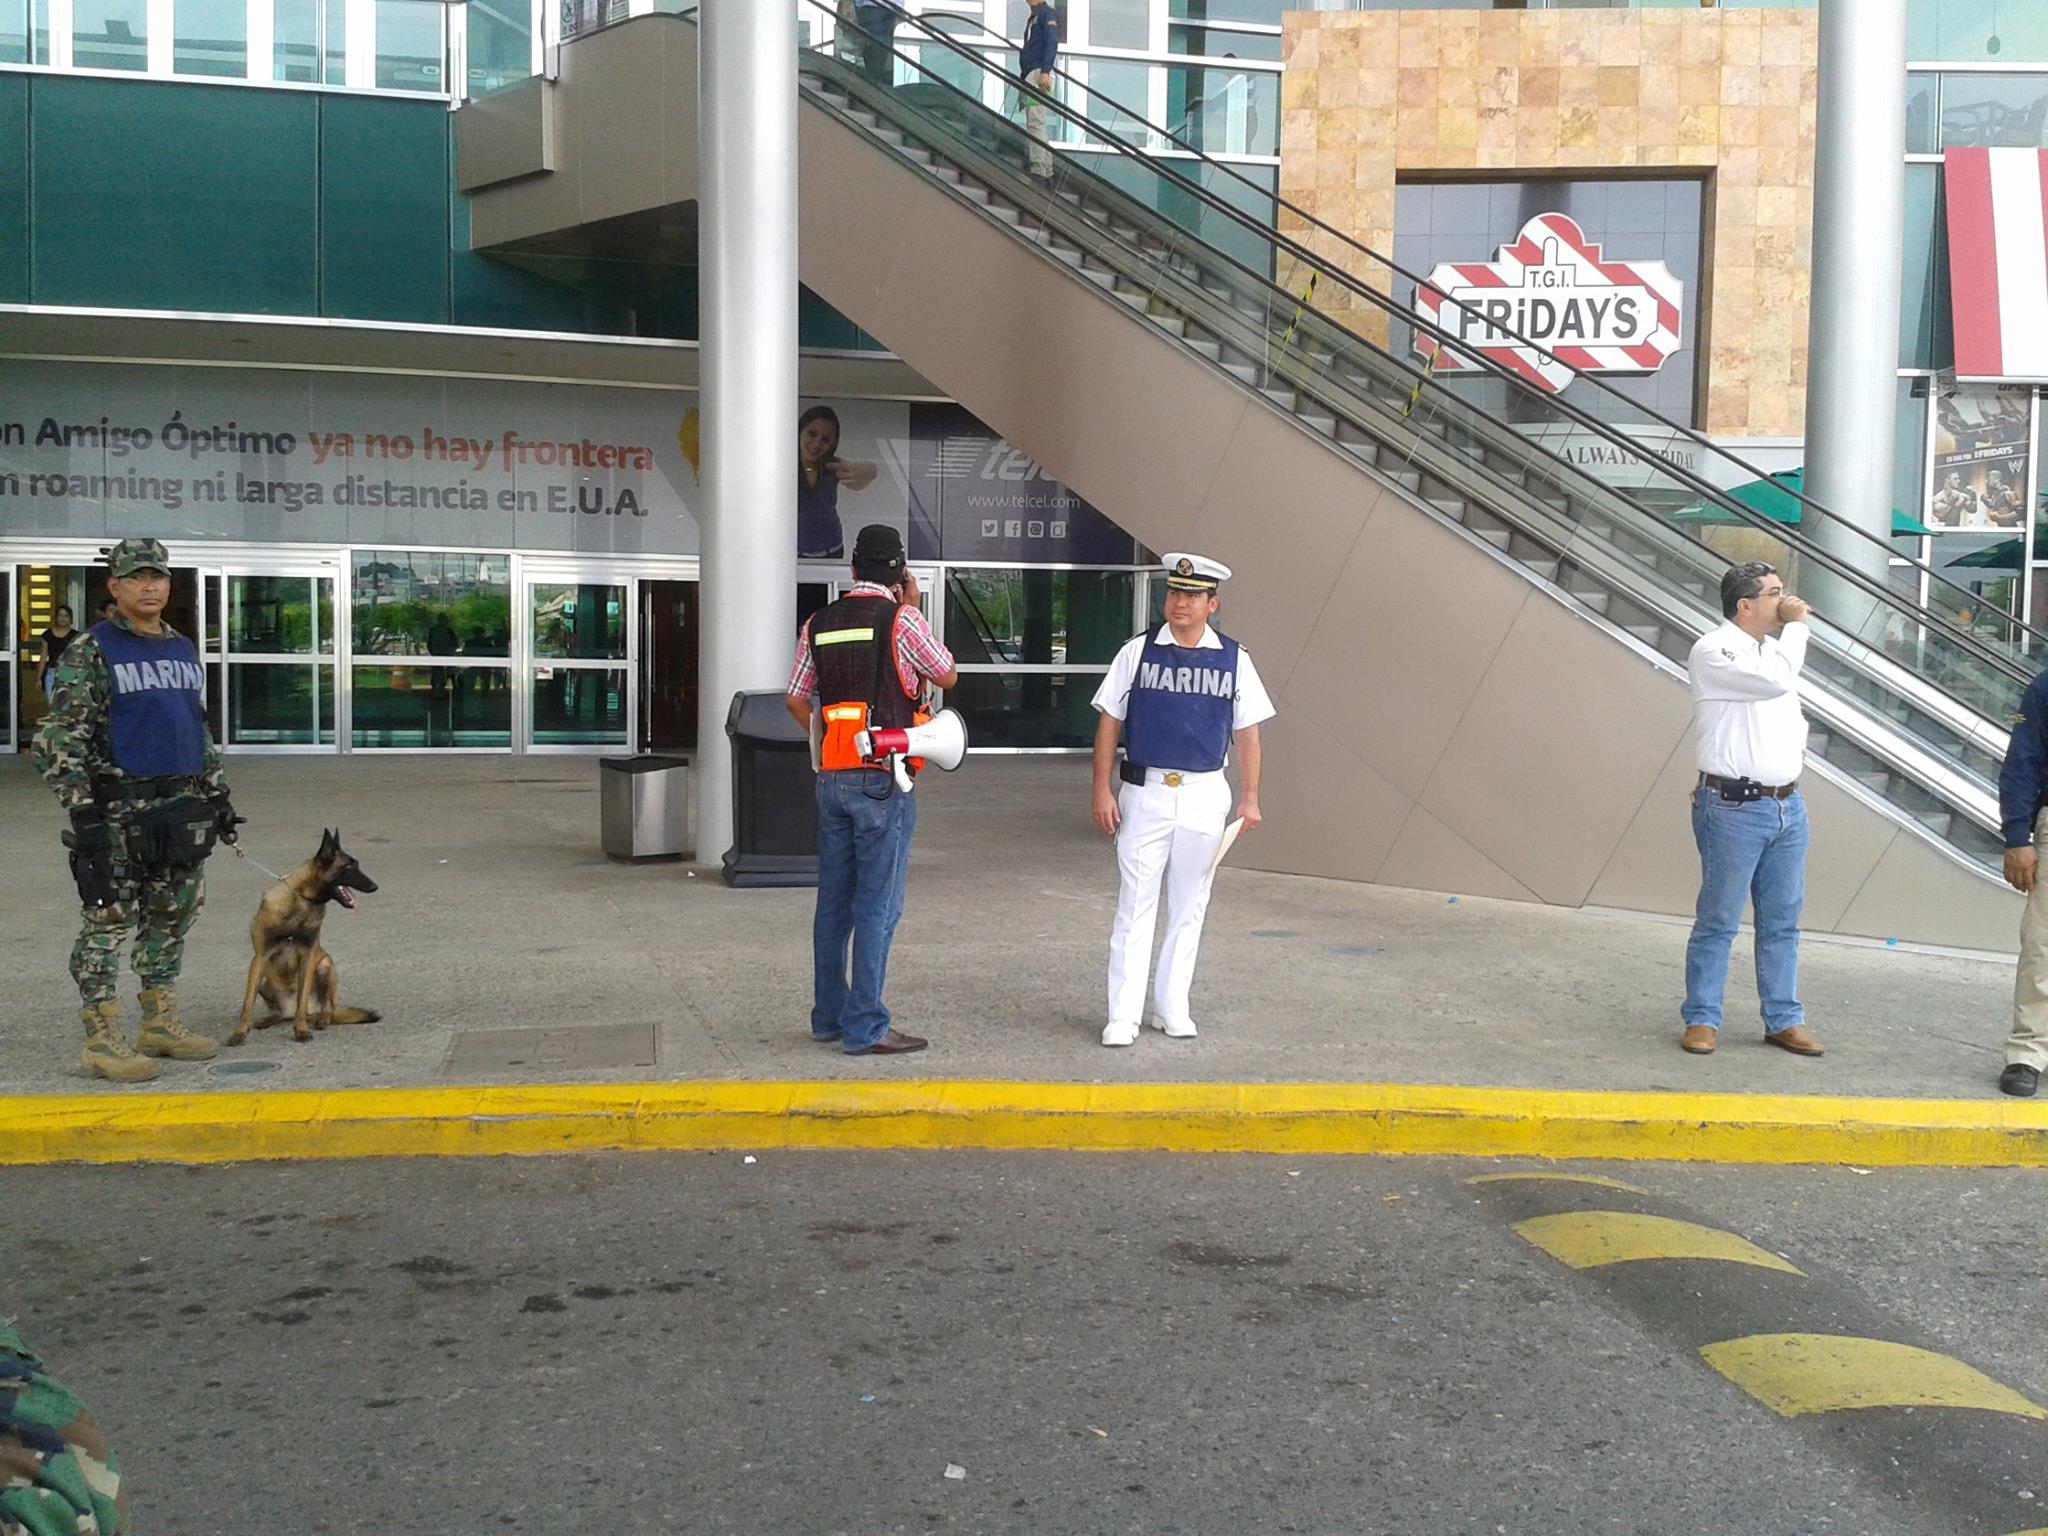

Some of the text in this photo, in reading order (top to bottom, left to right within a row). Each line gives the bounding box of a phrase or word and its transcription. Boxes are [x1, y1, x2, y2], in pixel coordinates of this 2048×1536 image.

[1529, 270, 1570, 288] T.G.I.
[35, 417, 153, 457] Amigo
[161, 410, 297, 460] Óptimo
[308, 430, 354, 465] ya
[365, 433, 415, 460] no
[423, 427, 494, 472] hay
[503, 430, 654, 472] frontera
[30, 467, 184, 509] roaming
[192, 470, 228, 502] ni
[236, 472, 324, 512] larga
[332, 475, 489, 511] distancia
[497, 488, 538, 513] en
[547, 485, 649, 517] E.U.A.
[967, 495, 1081, 510] www.telcel.com
[1140, 662, 1233, 700] MARINA
